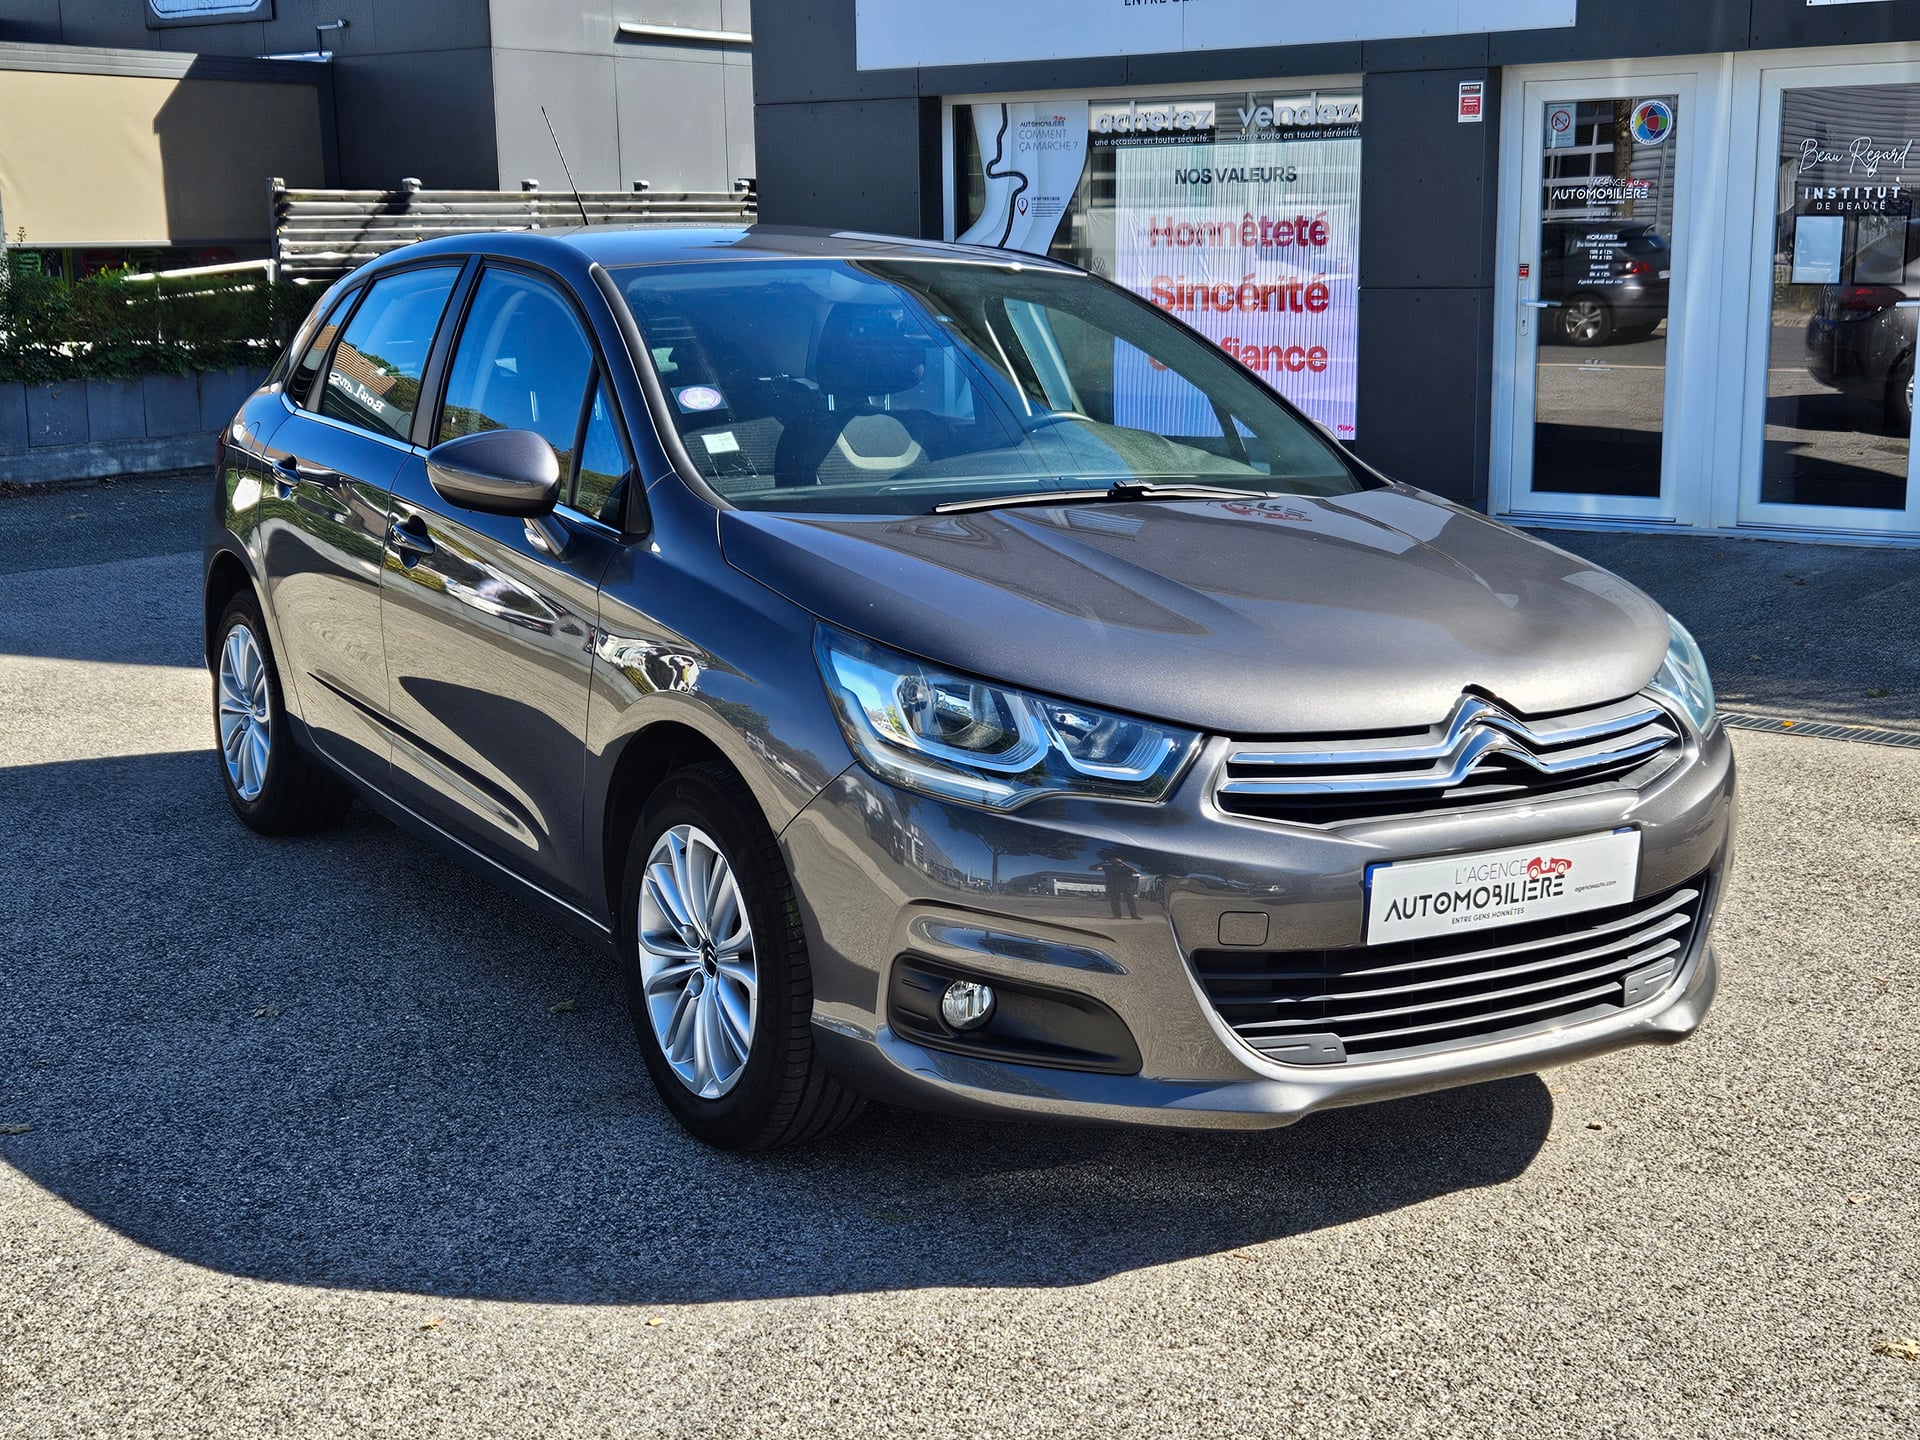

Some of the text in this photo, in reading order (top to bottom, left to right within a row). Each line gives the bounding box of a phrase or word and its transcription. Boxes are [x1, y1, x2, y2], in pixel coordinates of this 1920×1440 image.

[1095, 100, 1213, 134] achetez
[1237, 91, 1357, 128] vendez
[1018, 129, 1067, 140] COMMENT
[1110, 136, 1141, 146] occasion
[1155, 135, 1175, 144] toute
[1018, 140, 1079, 153] ÇA MARCHE ?
[1798, 136, 1913, 178] Beau Regard
[1175, 166, 1297, 185] NOS VALEURS
[1804, 186, 1901, 200] INSTITUT
[1816, 200, 1886, 210] DE BEAUTÉ
[1150, 211, 1331, 248] Honnêteté
[1151, 273, 1329, 313] Sincérité
[1455, 858, 1528, 885] L'AGENCE
[1451, 907, 1525, 924] ENTRE GENS HONNÊTES
